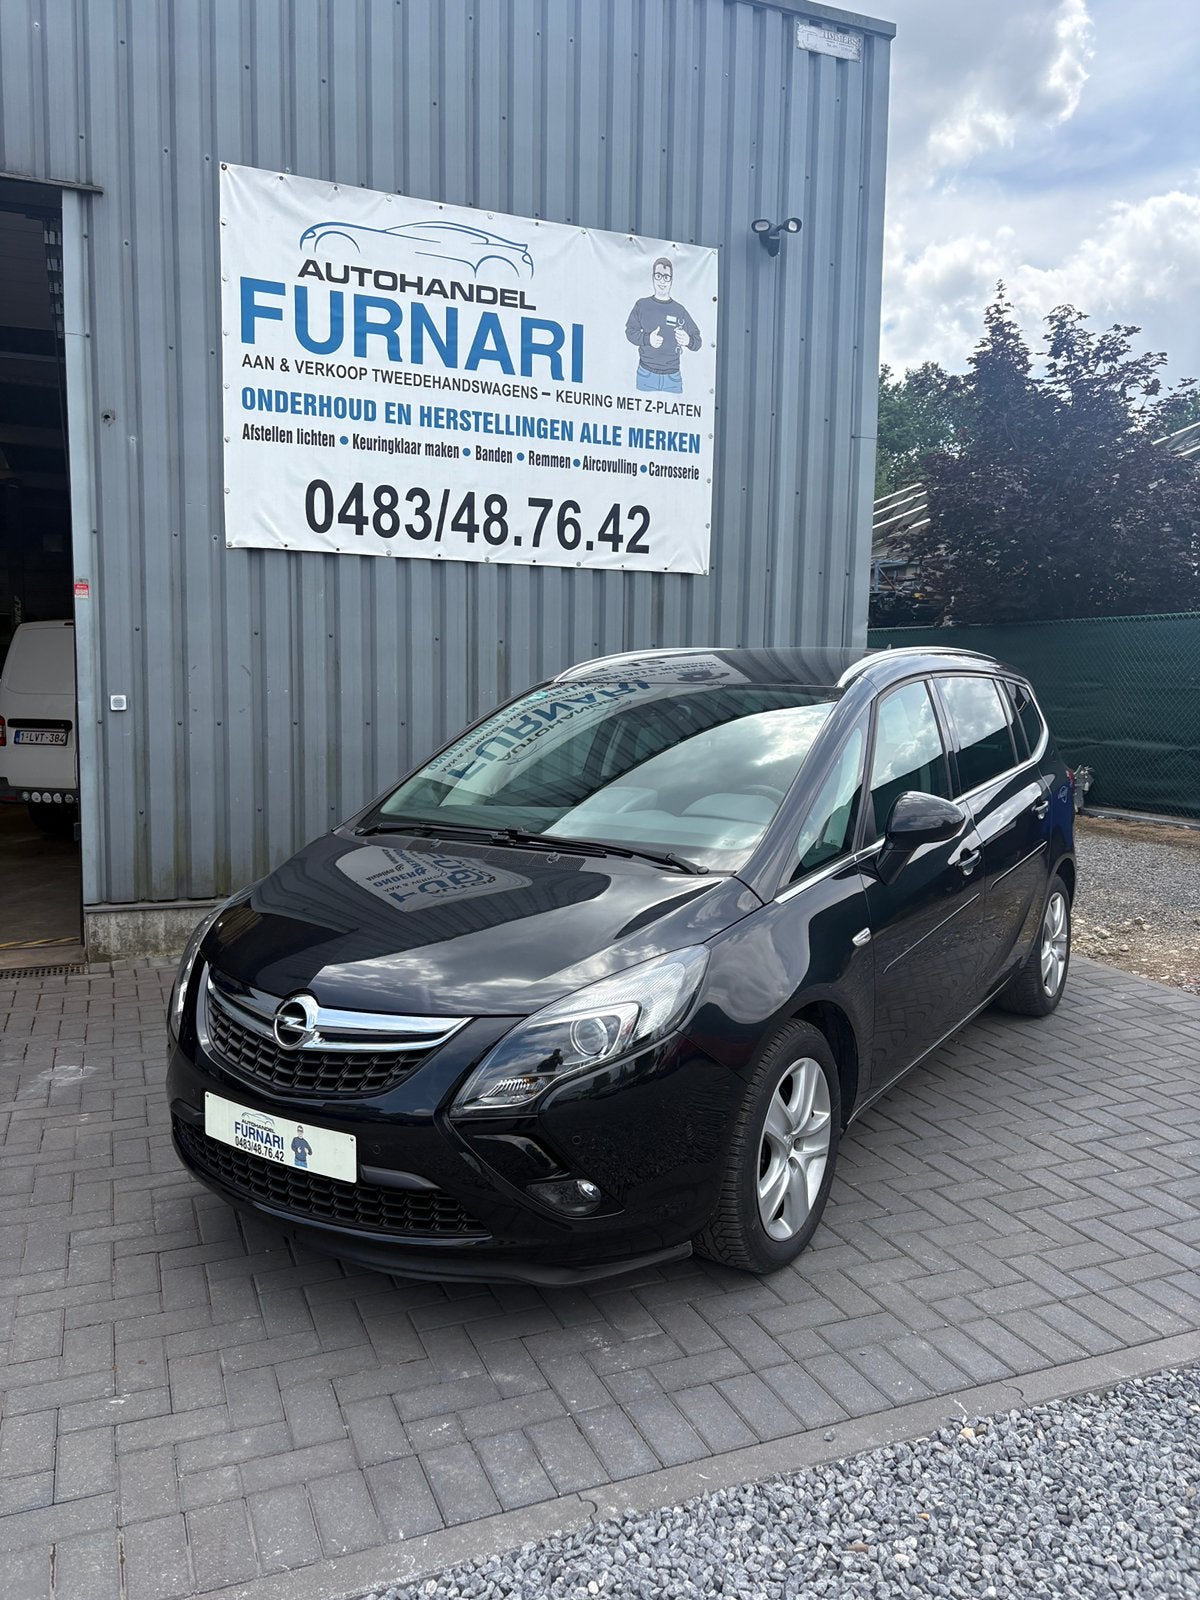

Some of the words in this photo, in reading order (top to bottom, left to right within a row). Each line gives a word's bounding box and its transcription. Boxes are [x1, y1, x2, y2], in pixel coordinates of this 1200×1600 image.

[298, 259, 537, 310] AUTOHANDEL
[240, 276, 584, 383] FURNARI
[242, 354, 275, 370] AAN
[280, 358, 291, 372] &
[295, 360, 368, 380] VERKOOP
[372, 369, 539, 399] TWEEDEHANDSWAGENS
[556, 390, 613, 408] KEURING
[617, 397, 642, 411] MET
[645, 400, 702, 417] Z-PLATEN
[242, 387, 377, 422] ONDERHOUD
[385, 402, 412, 425] EN
[420, 406, 574, 441] HERSTELLINGEN
[580, 423, 622, 447] ALLE
[628, 428, 701, 454] MERKEN
[242, 424, 293, 443] Afstellen
[296, 428, 336, 447] lichten
[352, 434, 422, 455] Keuringklaar
[424, 441, 460, 459] maken
[475, 445, 513, 464] Banden
[529, 450, 571, 469] Remmen
[583, 456, 638, 476] Aircovulling
[649, 462, 700, 480] Carrosserie
[306, 479, 651, 554] 0483/48.76.42
[234, 1121, 284, 1150] FURNARI
[234, 1136, 284, 1162] 0483/48.76.42
[241, 1119, 275, 1134] AUTOHANDEL
